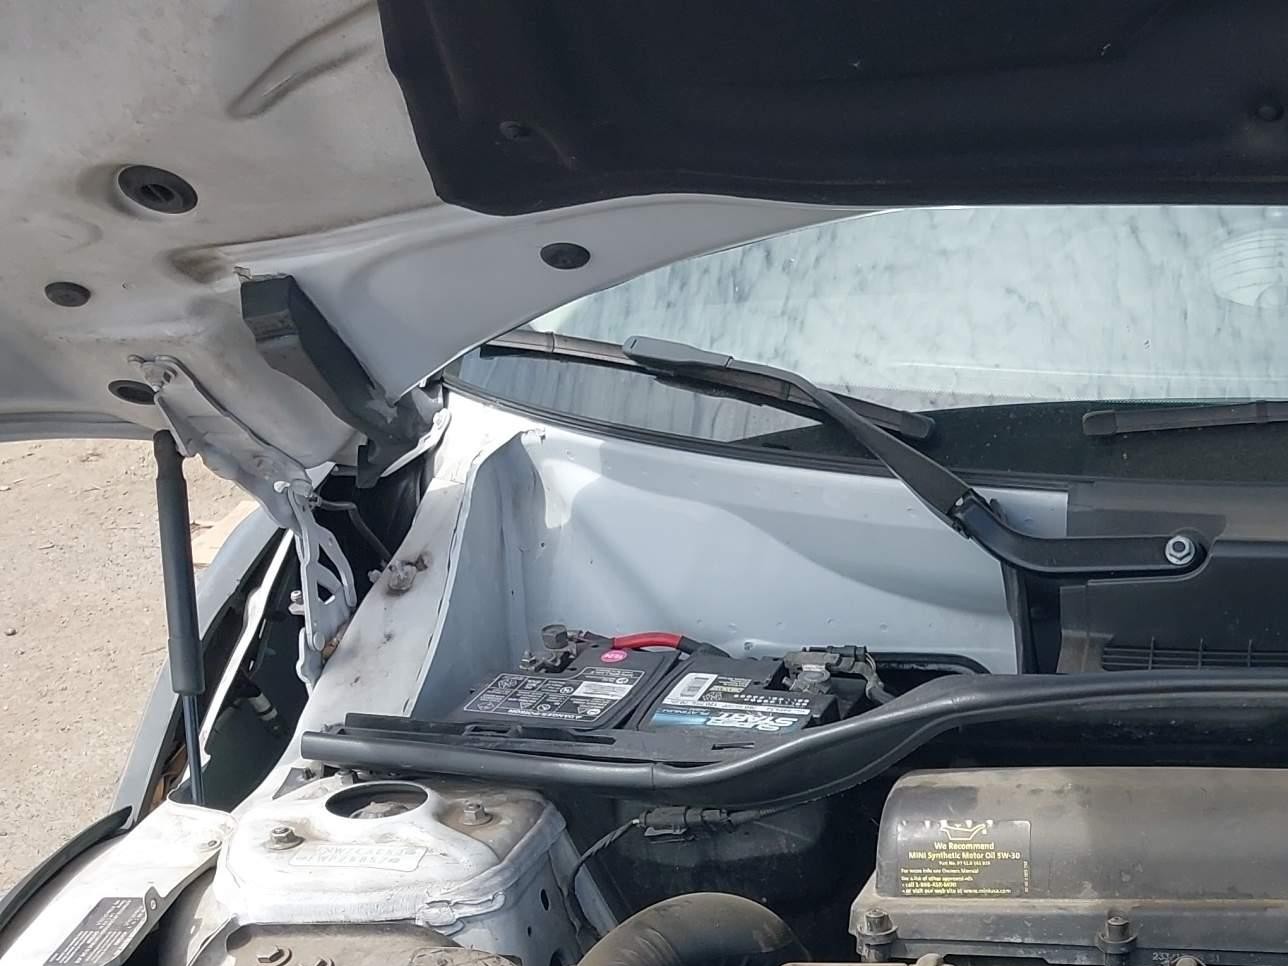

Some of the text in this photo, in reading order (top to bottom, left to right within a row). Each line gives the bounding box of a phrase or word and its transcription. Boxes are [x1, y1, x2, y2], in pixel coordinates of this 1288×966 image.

[934, 842, 994, 850] We Recommend
[909, 851, 1021, 861] MINI Synthetic Motor Oil 5W-30
